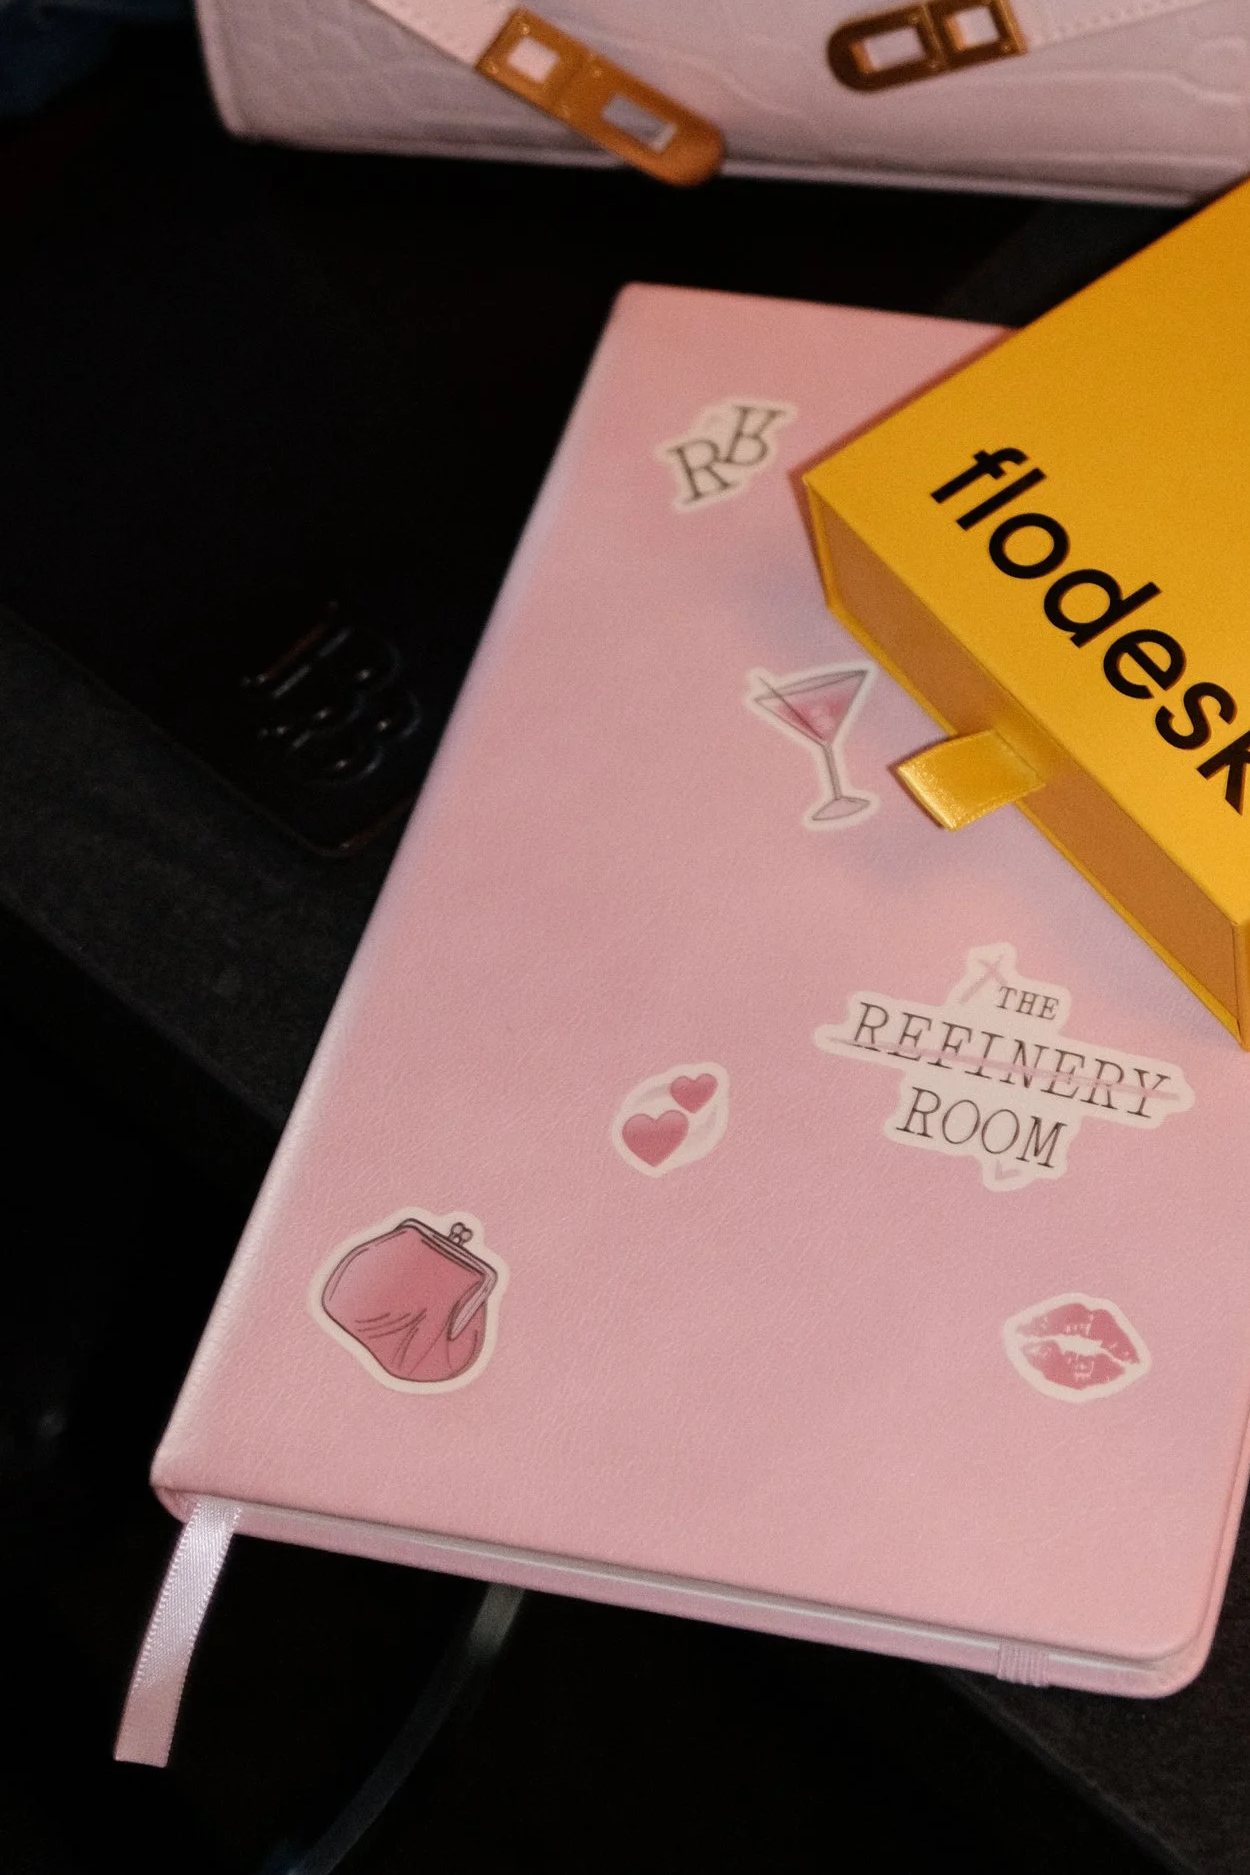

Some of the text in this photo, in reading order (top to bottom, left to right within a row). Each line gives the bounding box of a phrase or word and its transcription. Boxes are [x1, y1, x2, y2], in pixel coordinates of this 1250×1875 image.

[995, 985, 1061, 1021] THE
[850, 1001, 1172, 1119] REFINERY
[895, 1086, 1069, 1169] ROOM
